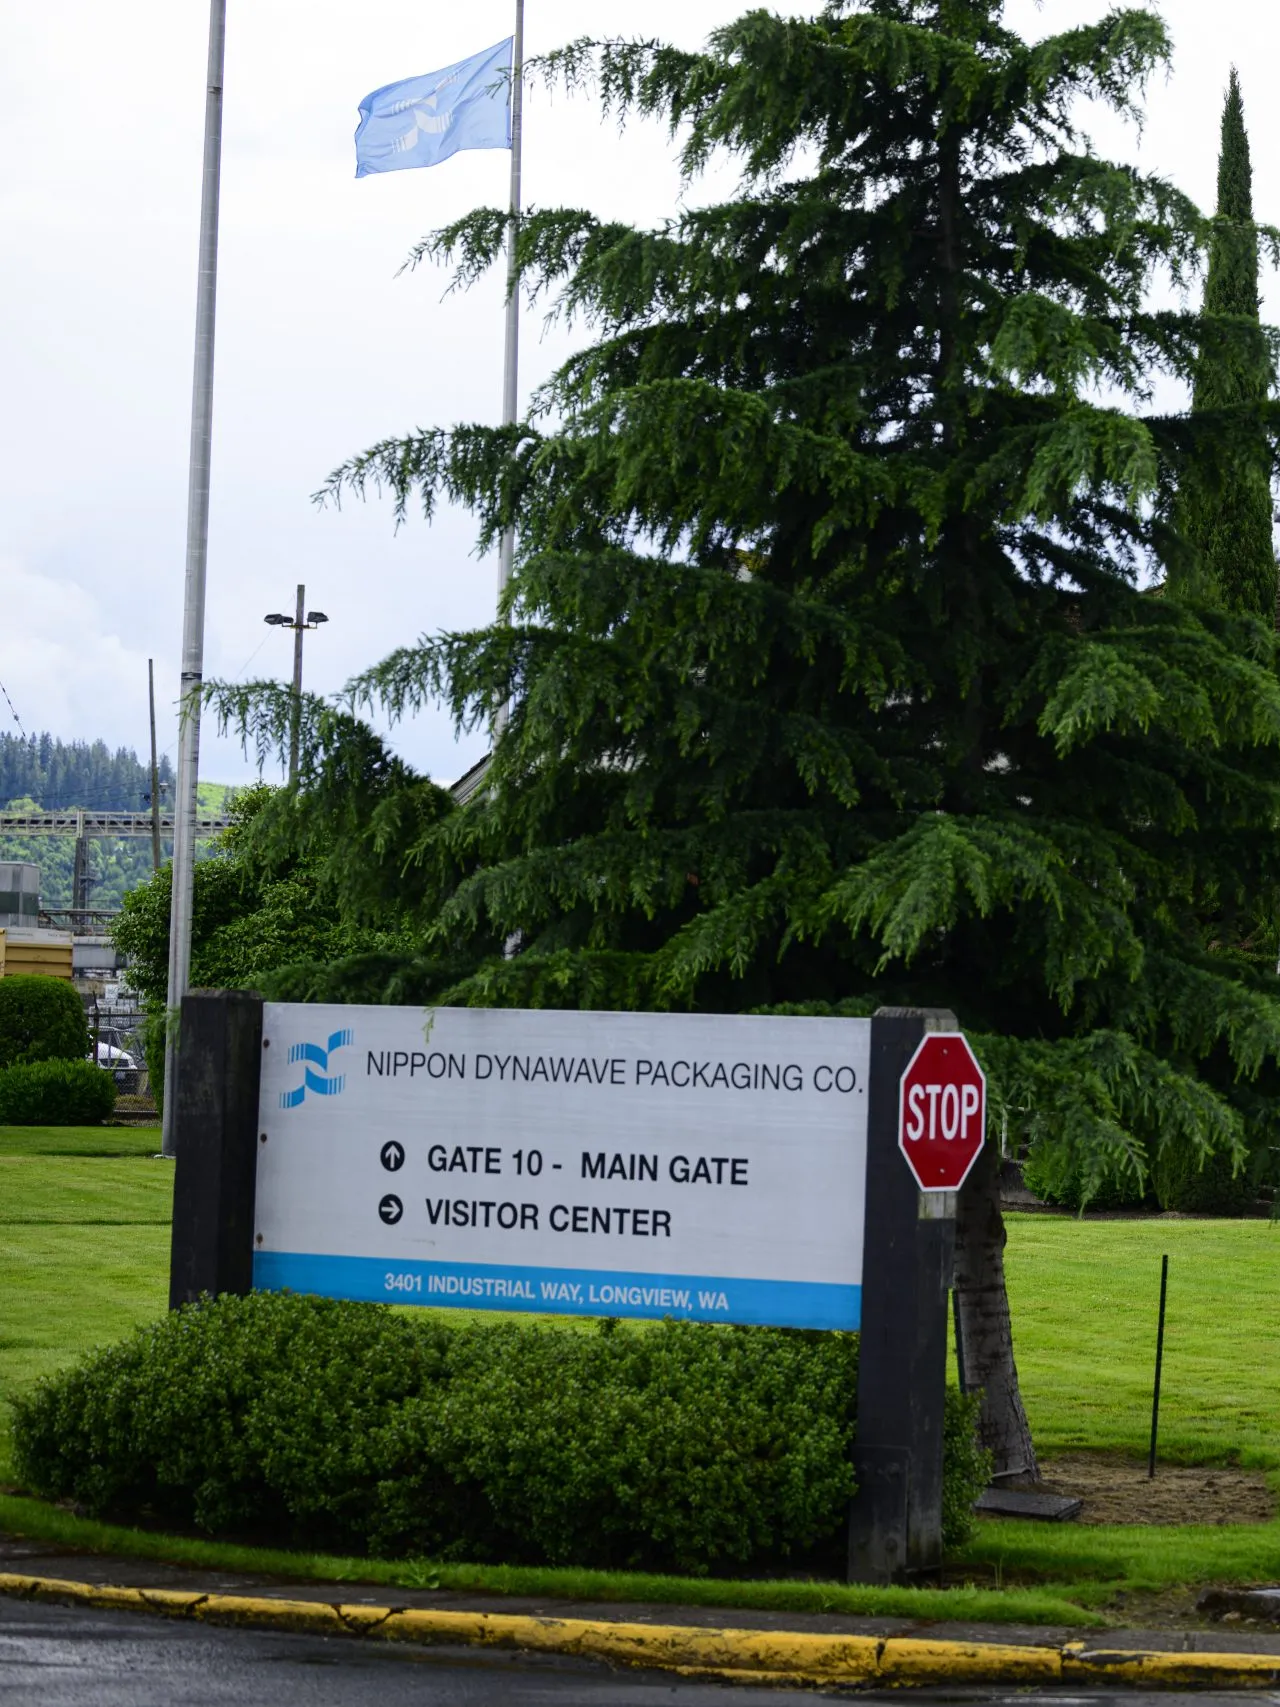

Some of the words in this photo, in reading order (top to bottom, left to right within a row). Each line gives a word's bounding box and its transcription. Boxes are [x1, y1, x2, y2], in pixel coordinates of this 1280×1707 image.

[367, 1050, 466, 1078] NIPPON
[475, 1054, 626, 1084] DYNAWAVE
[636, 1060, 803, 1092] PACKAGING
[813, 1066, 864, 1093] CO.
[906, 1083, 980, 1141] STOP
[427, 1144, 501, 1174] GATE
[511, 1149, 543, 1176] 10
[581, 1152, 658, 1181] MAIN
[669, 1156, 749, 1186] GATE
[425, 1198, 539, 1230] VISITOR
[549, 1204, 671, 1236] CENTER
[384, 1273, 422, 1292] 3401
[428, 1275, 536, 1299] INDUSTRIAL
[540, 1282, 583, 1304] WAY,
[589, 1285, 693, 1311] LONGVIEW,
[699, 1290, 729, 1310] WA
